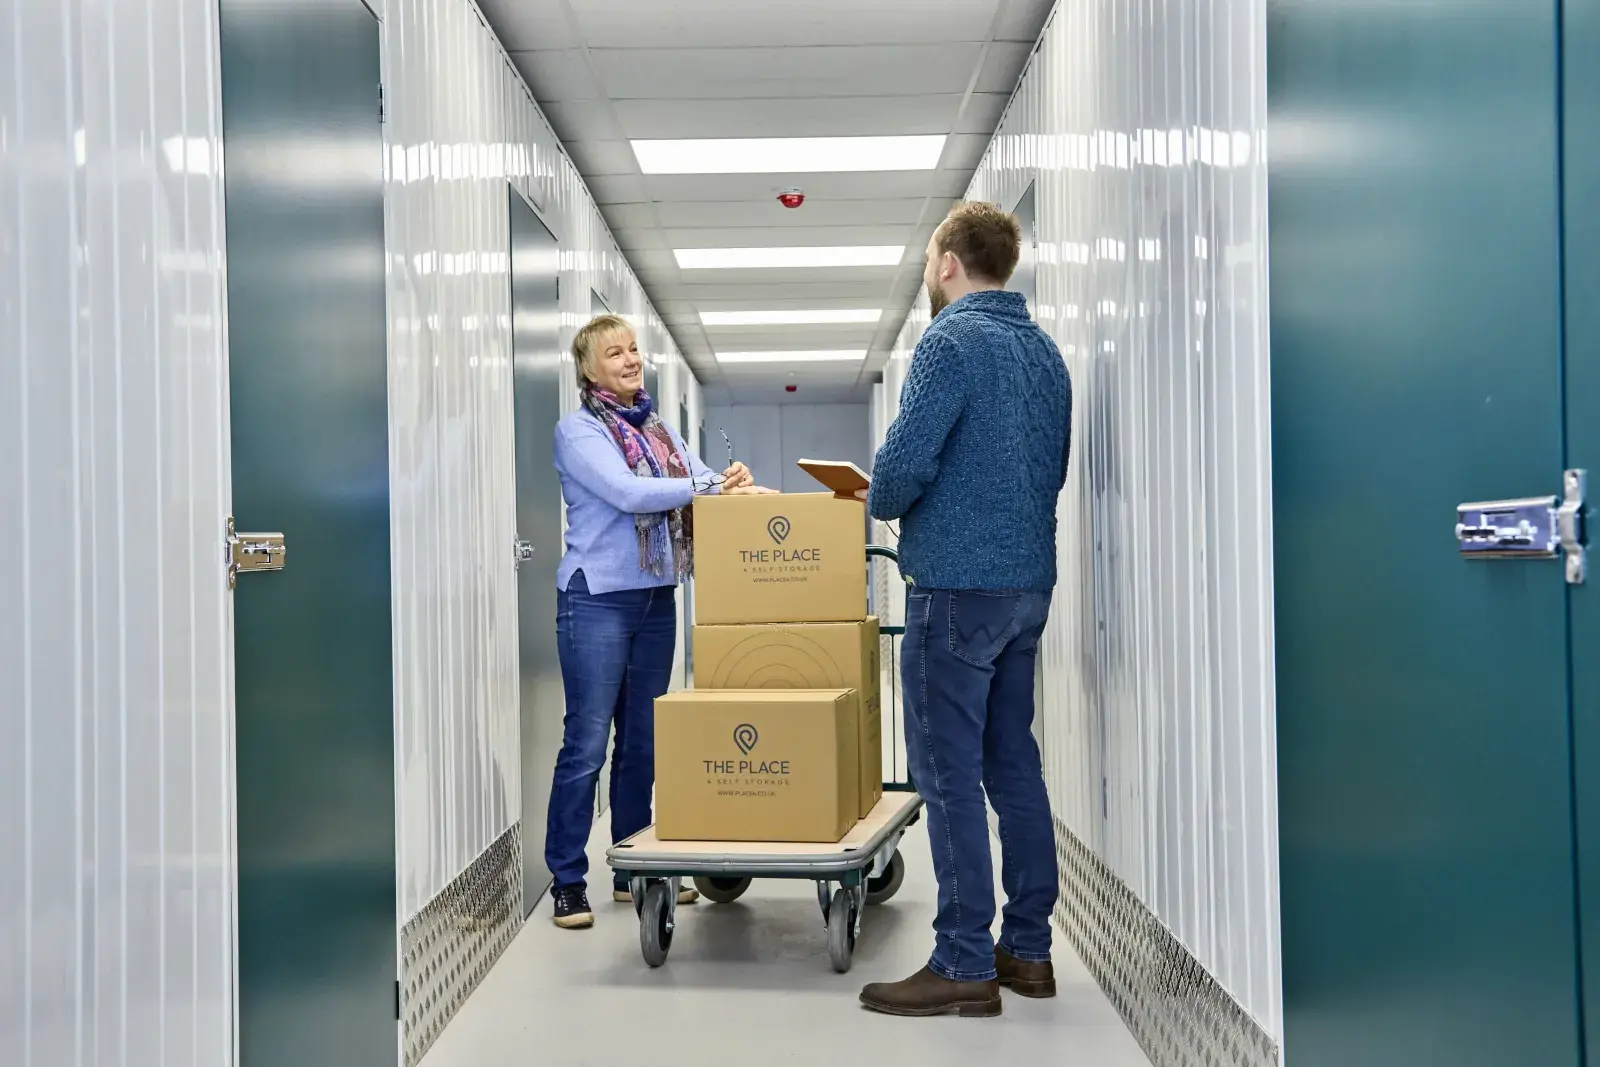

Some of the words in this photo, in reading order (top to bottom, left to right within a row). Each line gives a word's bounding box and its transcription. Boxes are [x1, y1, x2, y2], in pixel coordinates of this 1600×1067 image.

[739, 549, 769, 563] THE
[773, 548, 821, 562] PLACE
[778, 565, 821, 573] STORAGE
[703, 760, 735, 774] THE
[739, 760, 790, 774] PLACE
[744, 778, 790, 786] STORAGE
